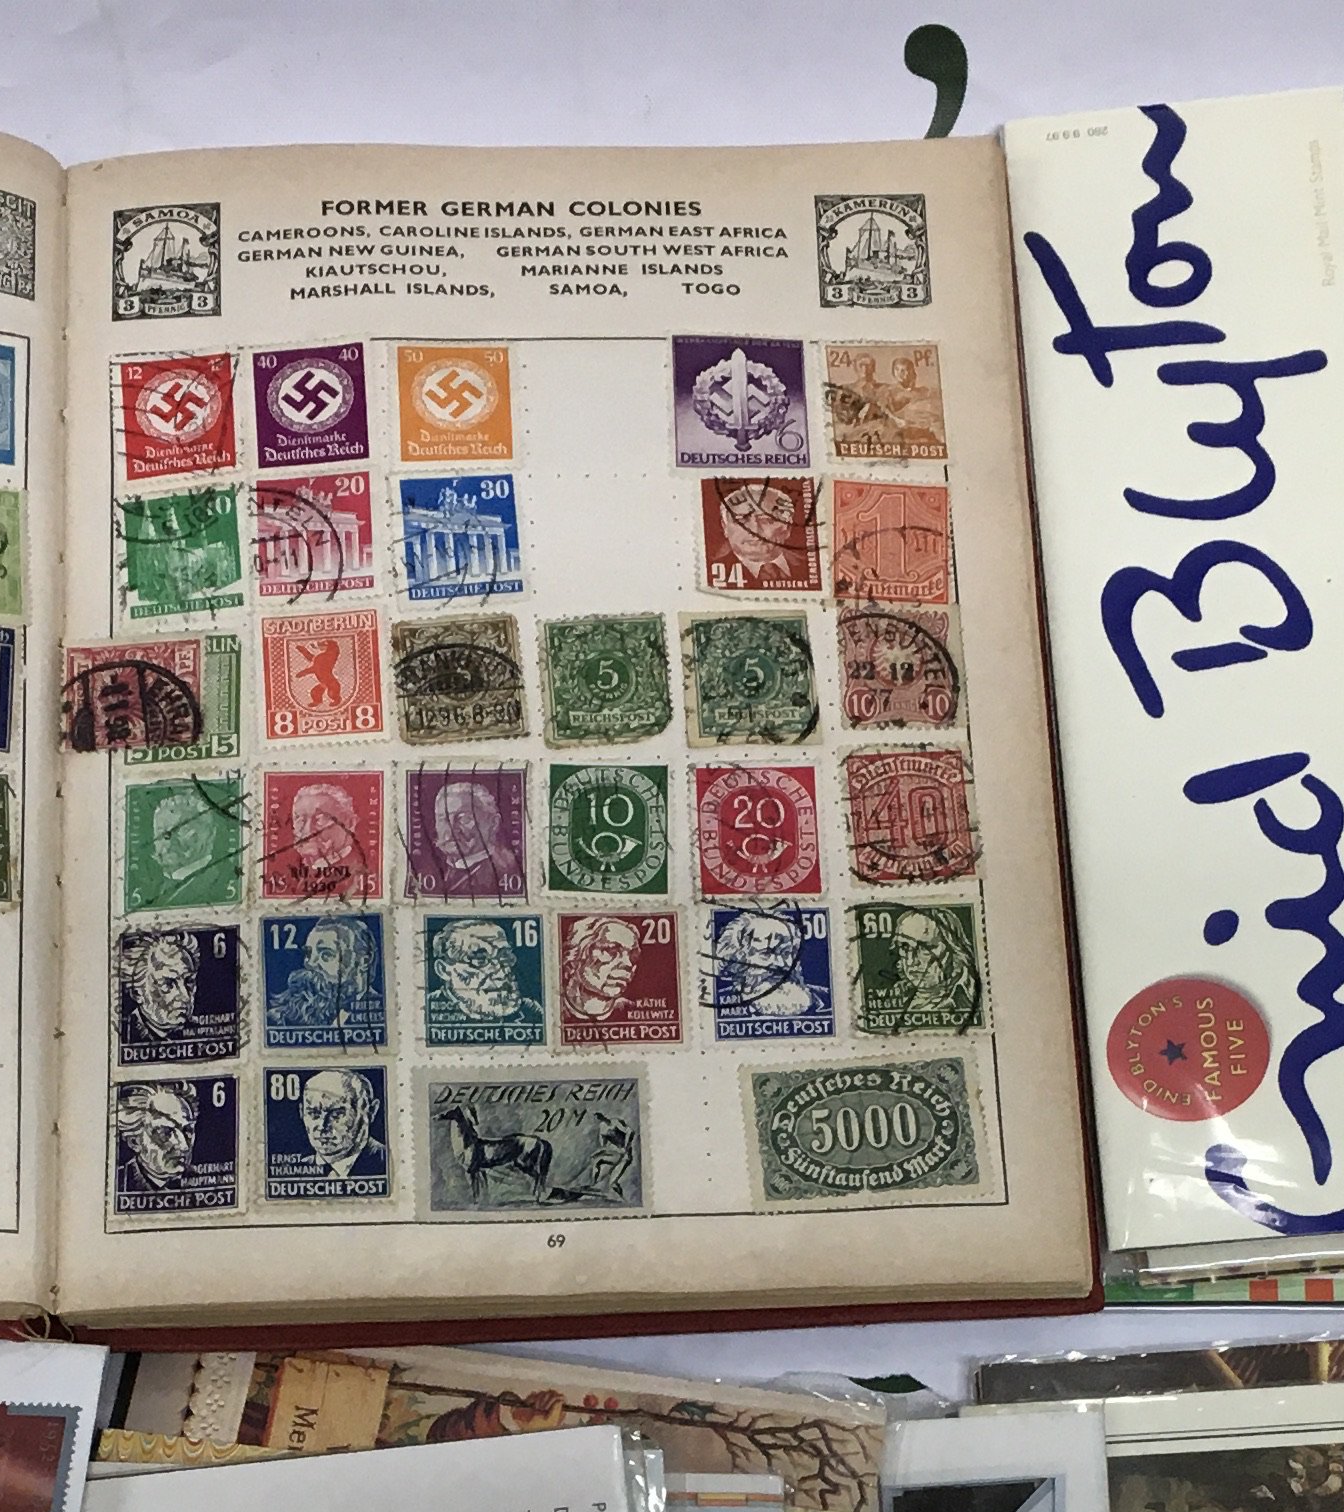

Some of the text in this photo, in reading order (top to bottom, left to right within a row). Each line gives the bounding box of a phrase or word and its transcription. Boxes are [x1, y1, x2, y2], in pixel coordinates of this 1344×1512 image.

[321, 200, 702, 217] FORMER GERMAN COLONIES
[238, 225, 787, 243] CAMEROONS, CAROLINE ISLANDS, GERMAN EAST AFRICA
[237, 245, 789, 262] GERMAN NEW GUINEA, GERMAN SOUTH WEST AFRICA
[306, 264, 723, 278] KIAUTSCHOU, MARIANNE ISLANDS
[290, 283, 741, 300] MARSHALL ISLANDS, SAMOA, TOGO
[1024, 104, 1329, 719] Blyton
[1196, 997, 1222, 1101] FAMOUS
[1226, 1019, 1248, 1075] FIVE
[270, 1074, 300, 1101] 80
[809, 1102, 918, 1153] 5000
[269, 1180, 386, 1197] DEUTSCHE POST
[547, 1234, 566, 1248] 69
